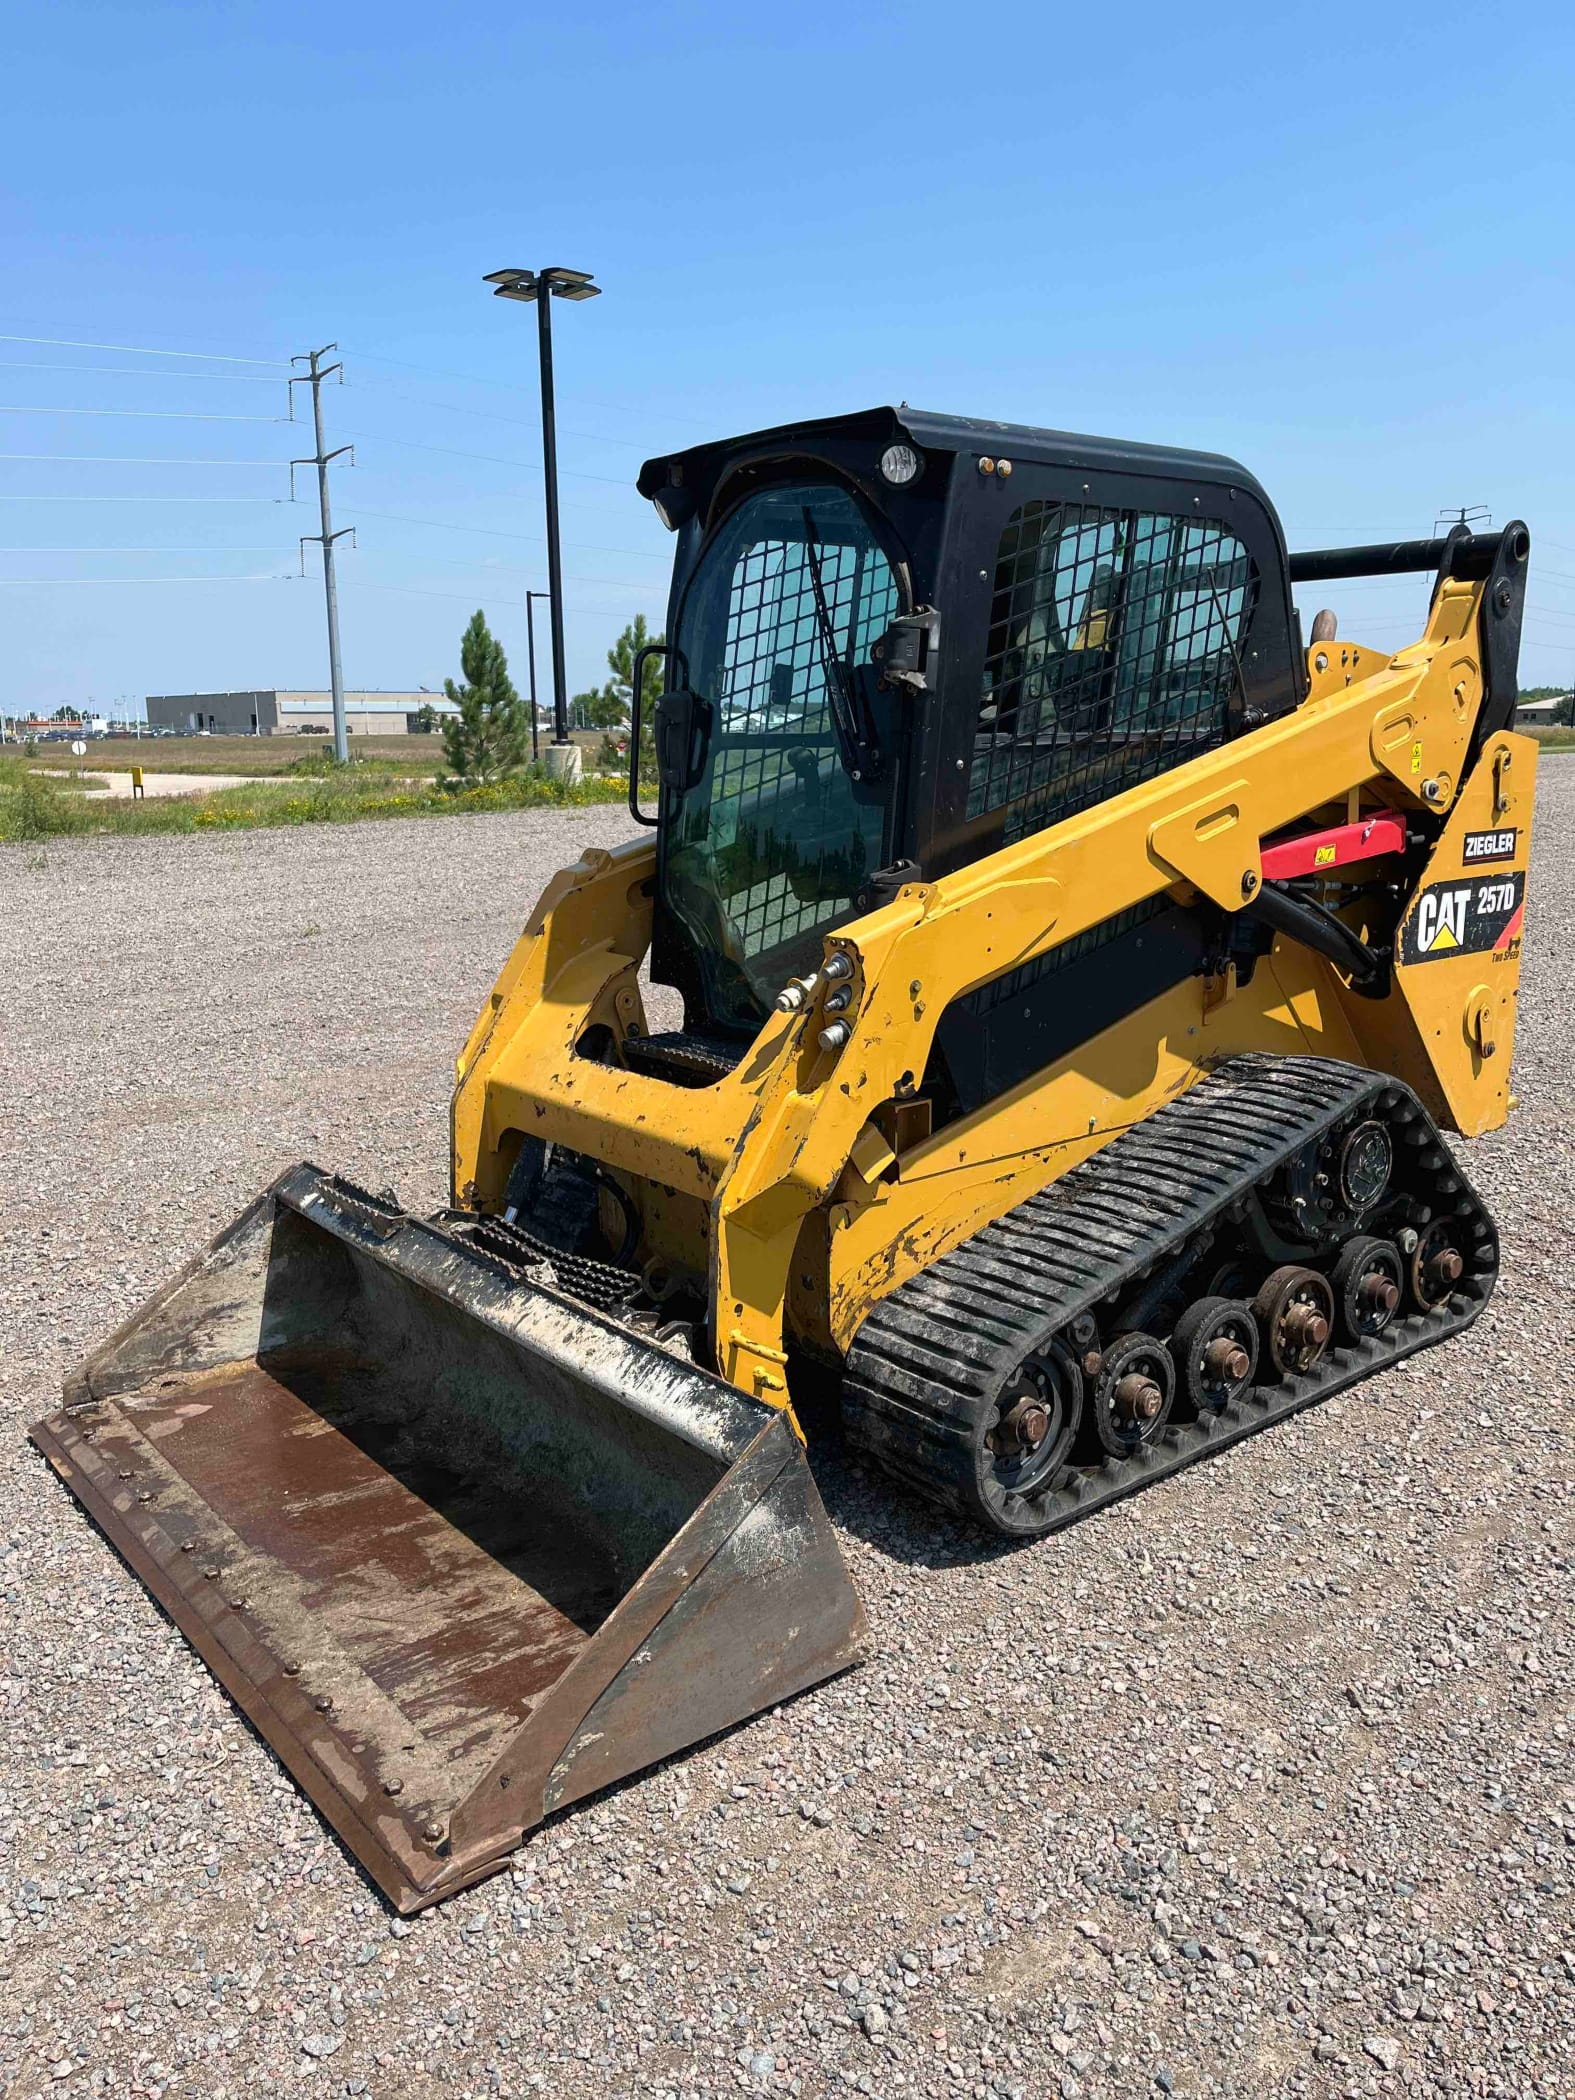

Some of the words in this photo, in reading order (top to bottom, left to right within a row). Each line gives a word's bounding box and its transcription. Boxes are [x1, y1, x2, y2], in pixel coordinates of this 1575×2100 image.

[1465, 832, 1514, 857] ZIEGLER
[1417, 889, 1472, 953] CAT
[1477, 883, 1515, 915] 257D
